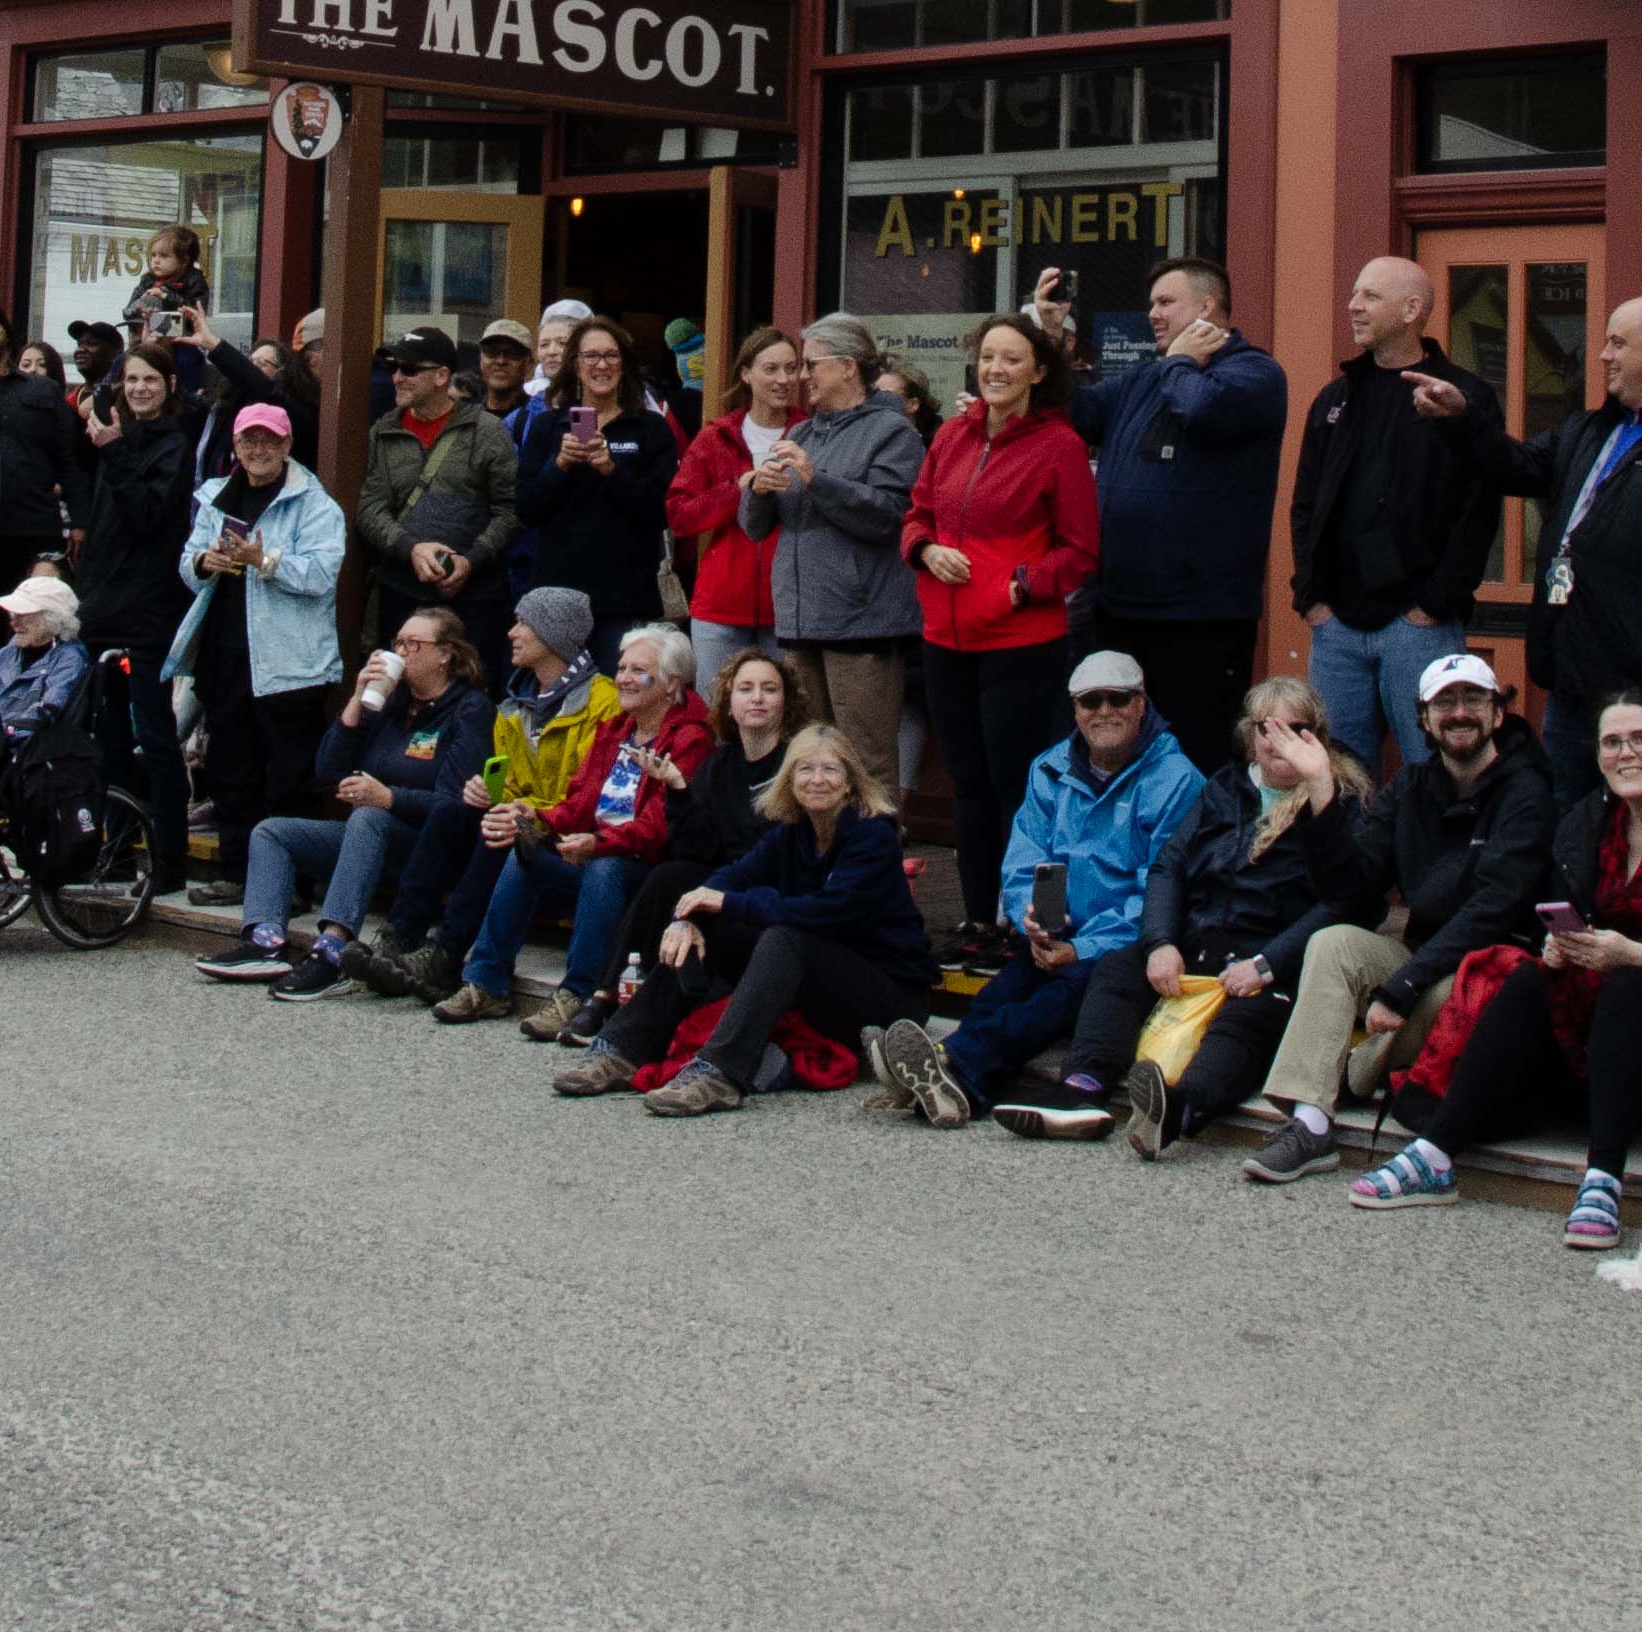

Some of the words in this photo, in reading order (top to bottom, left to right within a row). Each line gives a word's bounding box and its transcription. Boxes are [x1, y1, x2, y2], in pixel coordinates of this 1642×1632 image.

[943, 182, 1184, 249] REINERT
[70, 224, 218, 288] MAST
[907, 334, 958, 349] Mascot
[1102, 350, 1140, 362] Through
